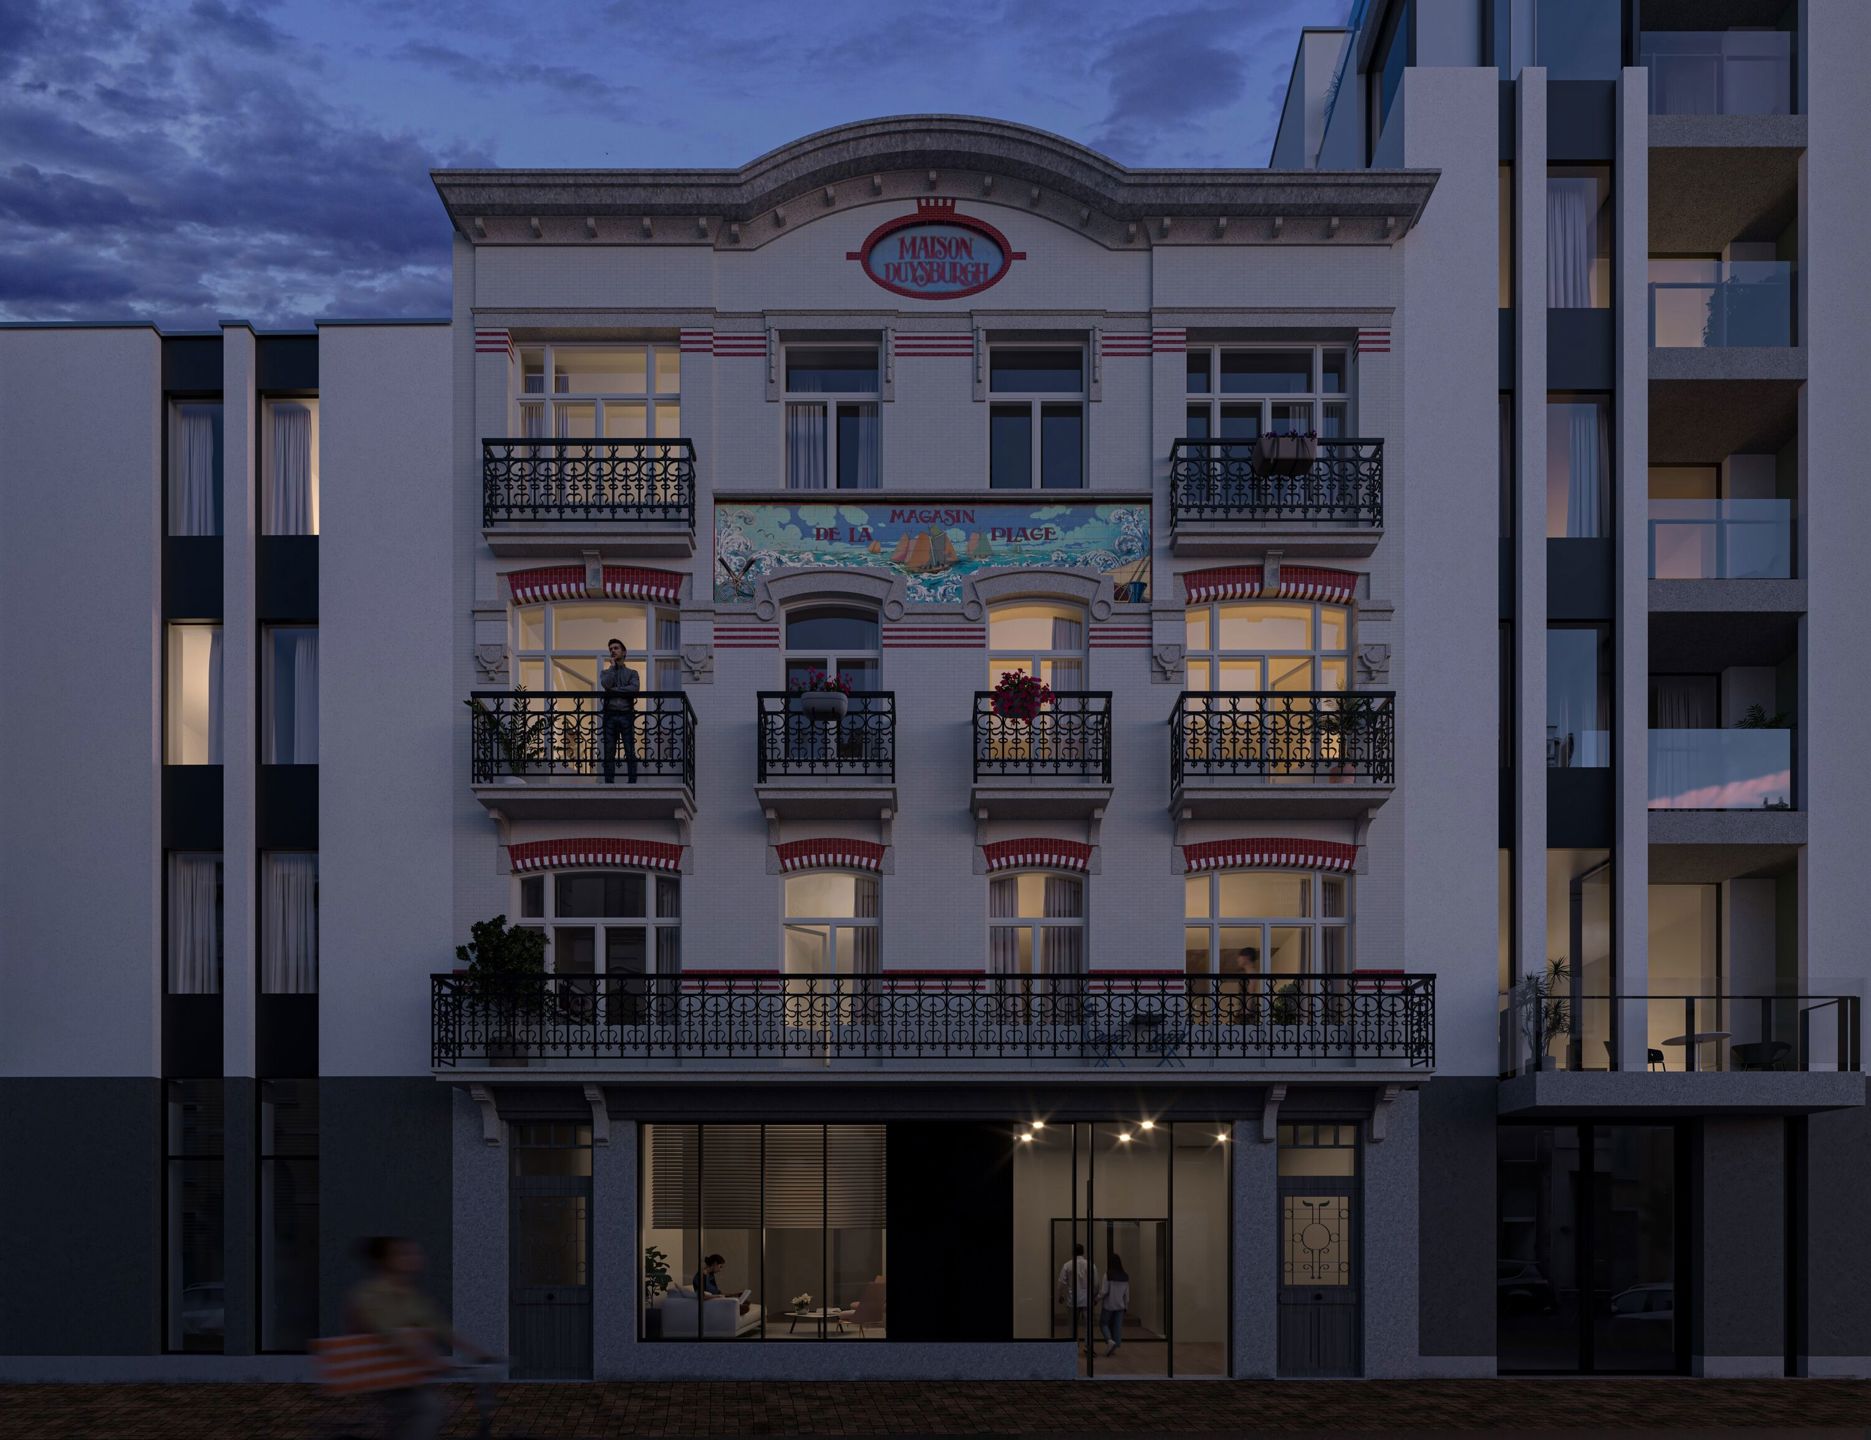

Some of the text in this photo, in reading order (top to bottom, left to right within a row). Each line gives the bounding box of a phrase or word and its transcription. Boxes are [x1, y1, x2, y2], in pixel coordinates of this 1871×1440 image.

[898, 236, 974, 260] MAISON
[884, 262, 989, 287] DUYSBURGH
[889, 509, 975, 525] MAGASIN
[815, 527, 1059, 542] DE LA PLAGE
